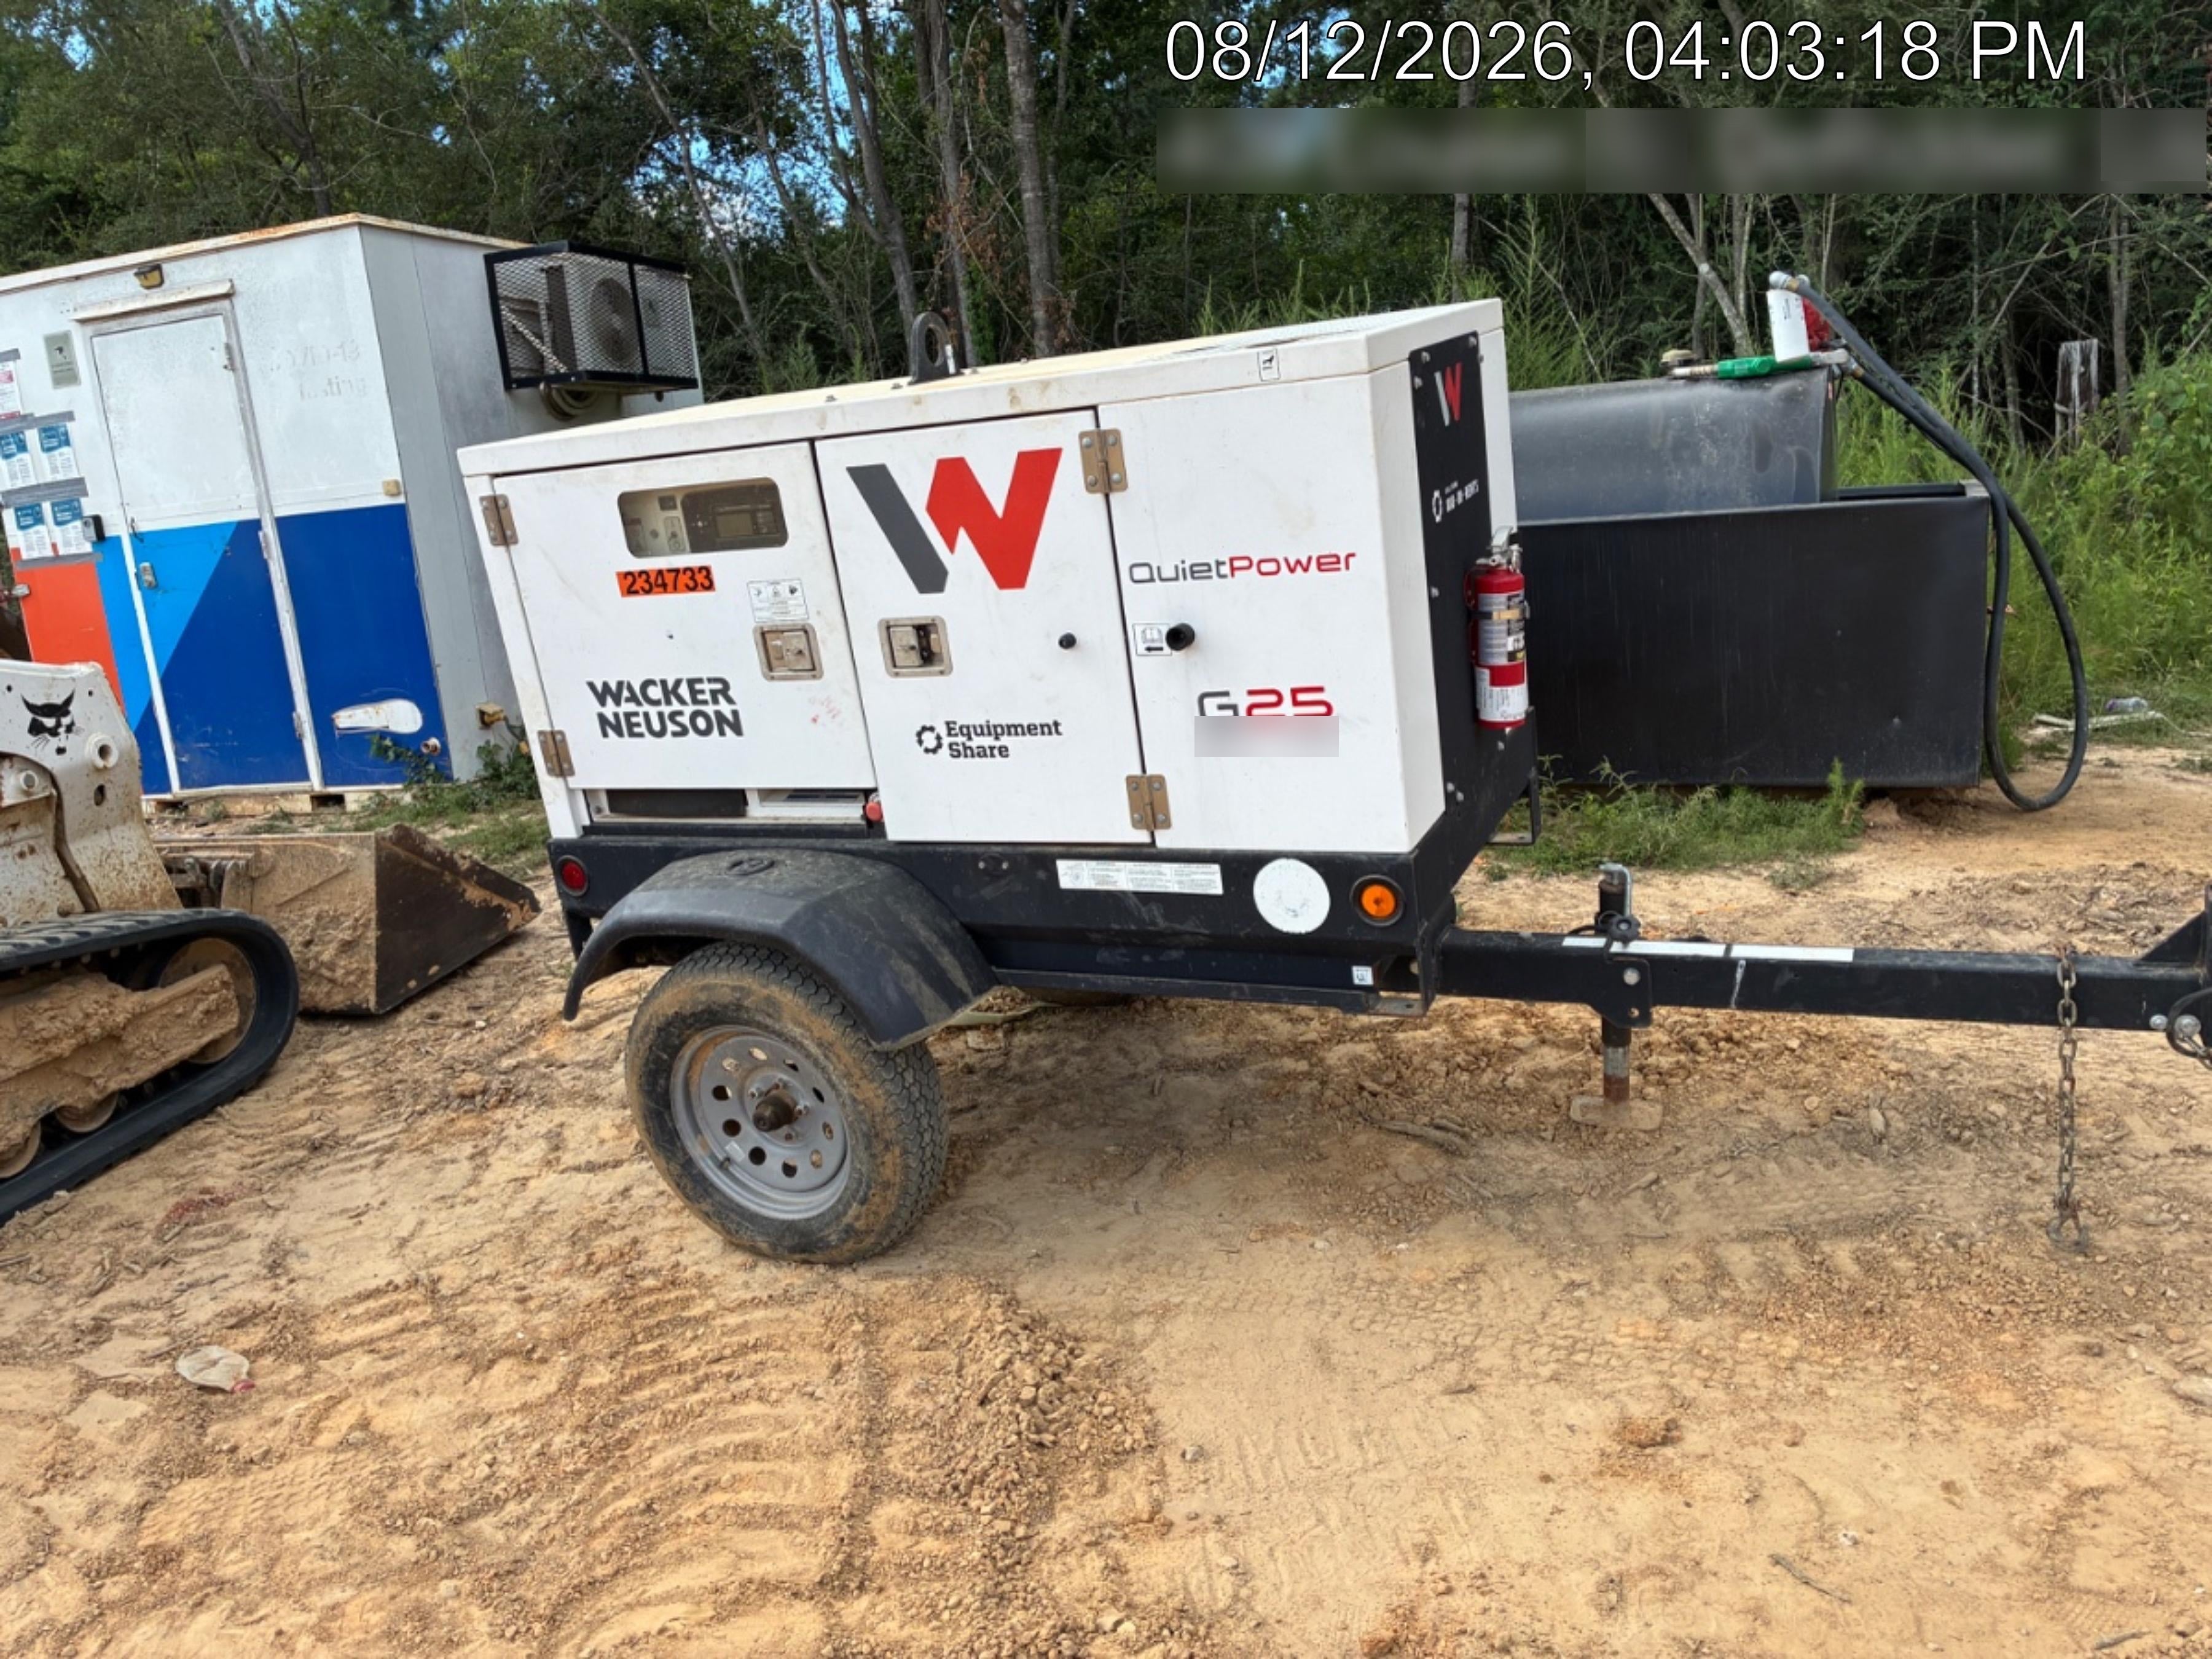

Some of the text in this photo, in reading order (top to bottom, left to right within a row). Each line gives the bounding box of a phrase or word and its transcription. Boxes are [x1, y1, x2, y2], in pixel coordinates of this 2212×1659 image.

[623, 565, 714, 595] 234733
[1129, 552, 1357, 584] QuietPower
[586, 677, 737, 708] WACKER
[1197, 685, 1334, 716] G25
[596, 708, 744, 739] NEUSON
[944, 720, 1063, 742] Equipment
[948, 741, 1010, 759] Share
